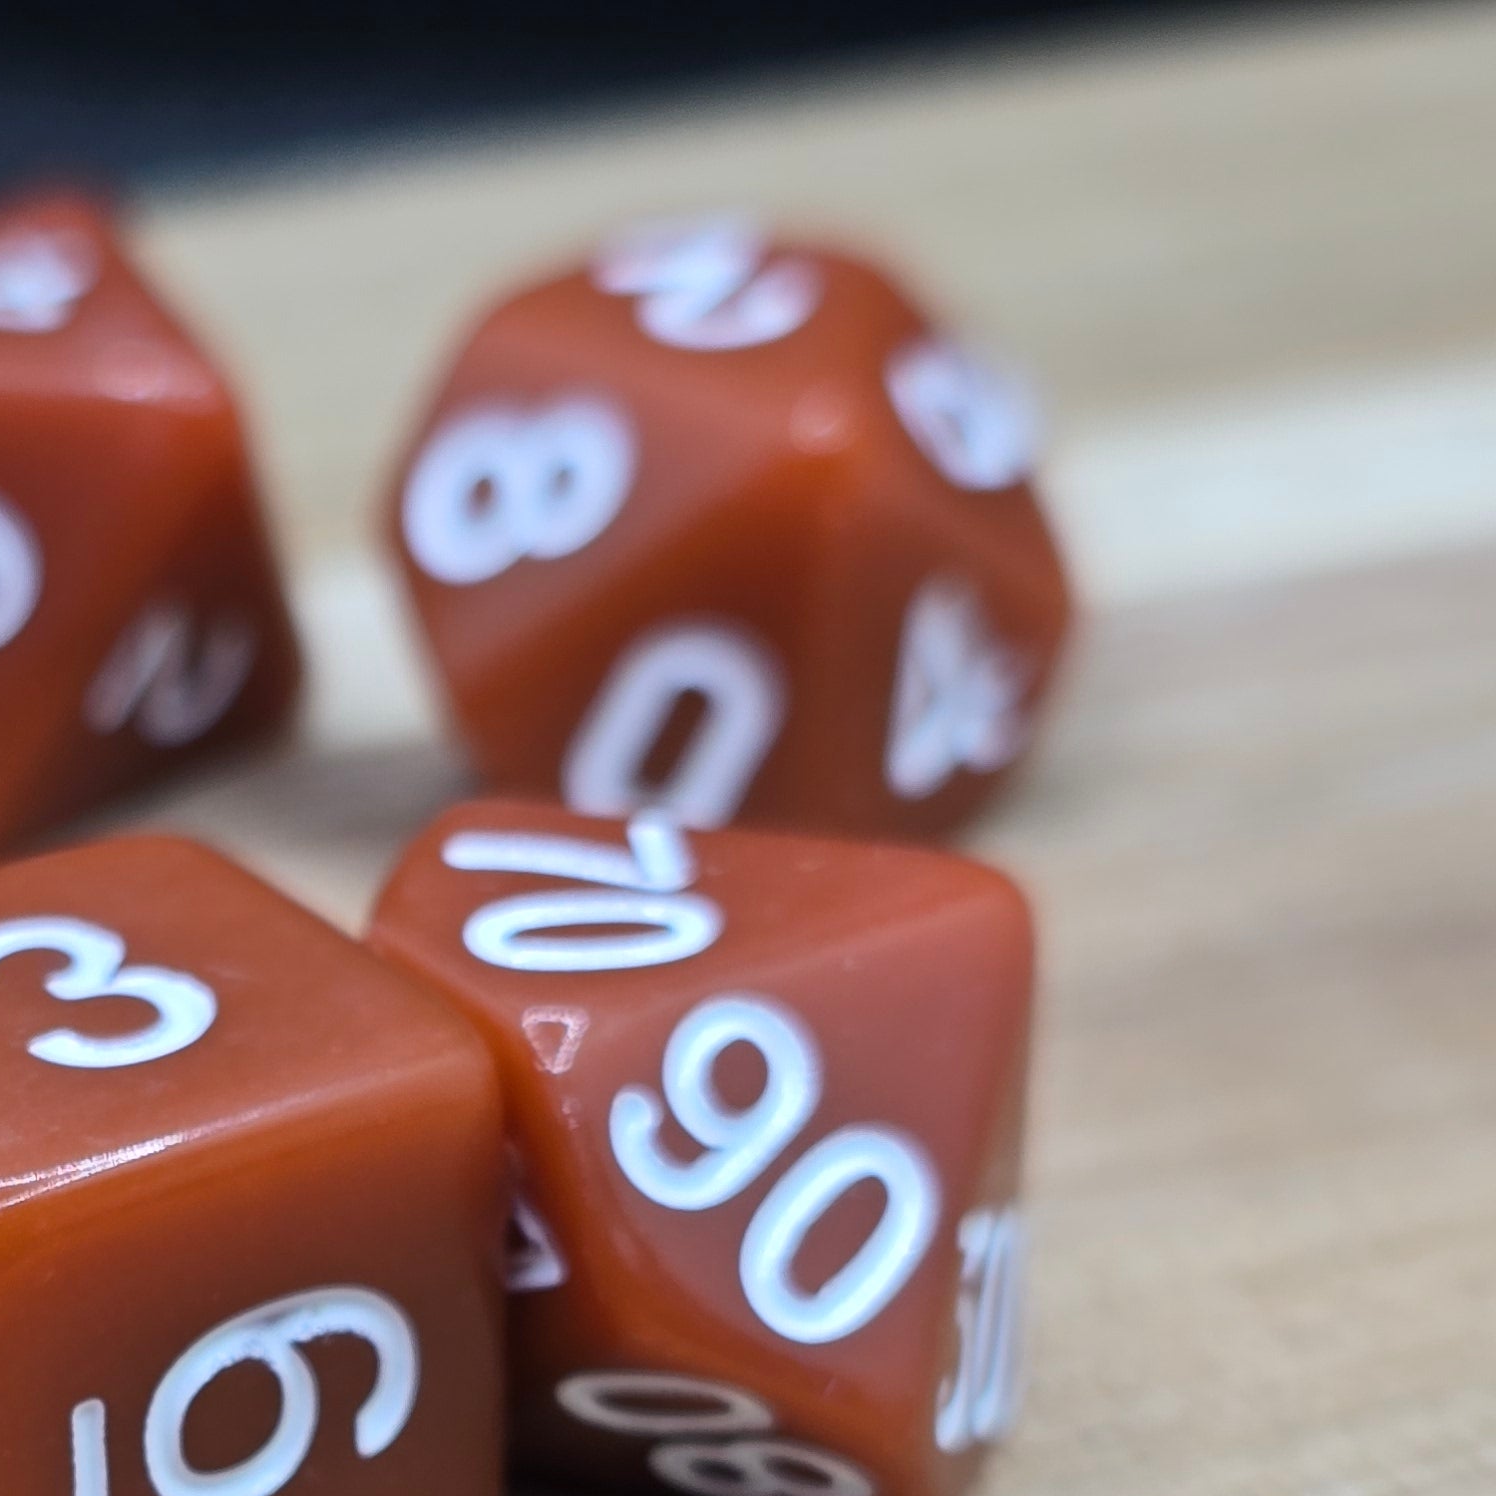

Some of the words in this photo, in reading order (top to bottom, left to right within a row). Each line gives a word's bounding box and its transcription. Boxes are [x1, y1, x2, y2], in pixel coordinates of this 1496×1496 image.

[402, 398, 636, 588] 8
[560, 622, 790, 830] 0
[608, 992, 940, 1346] 90
